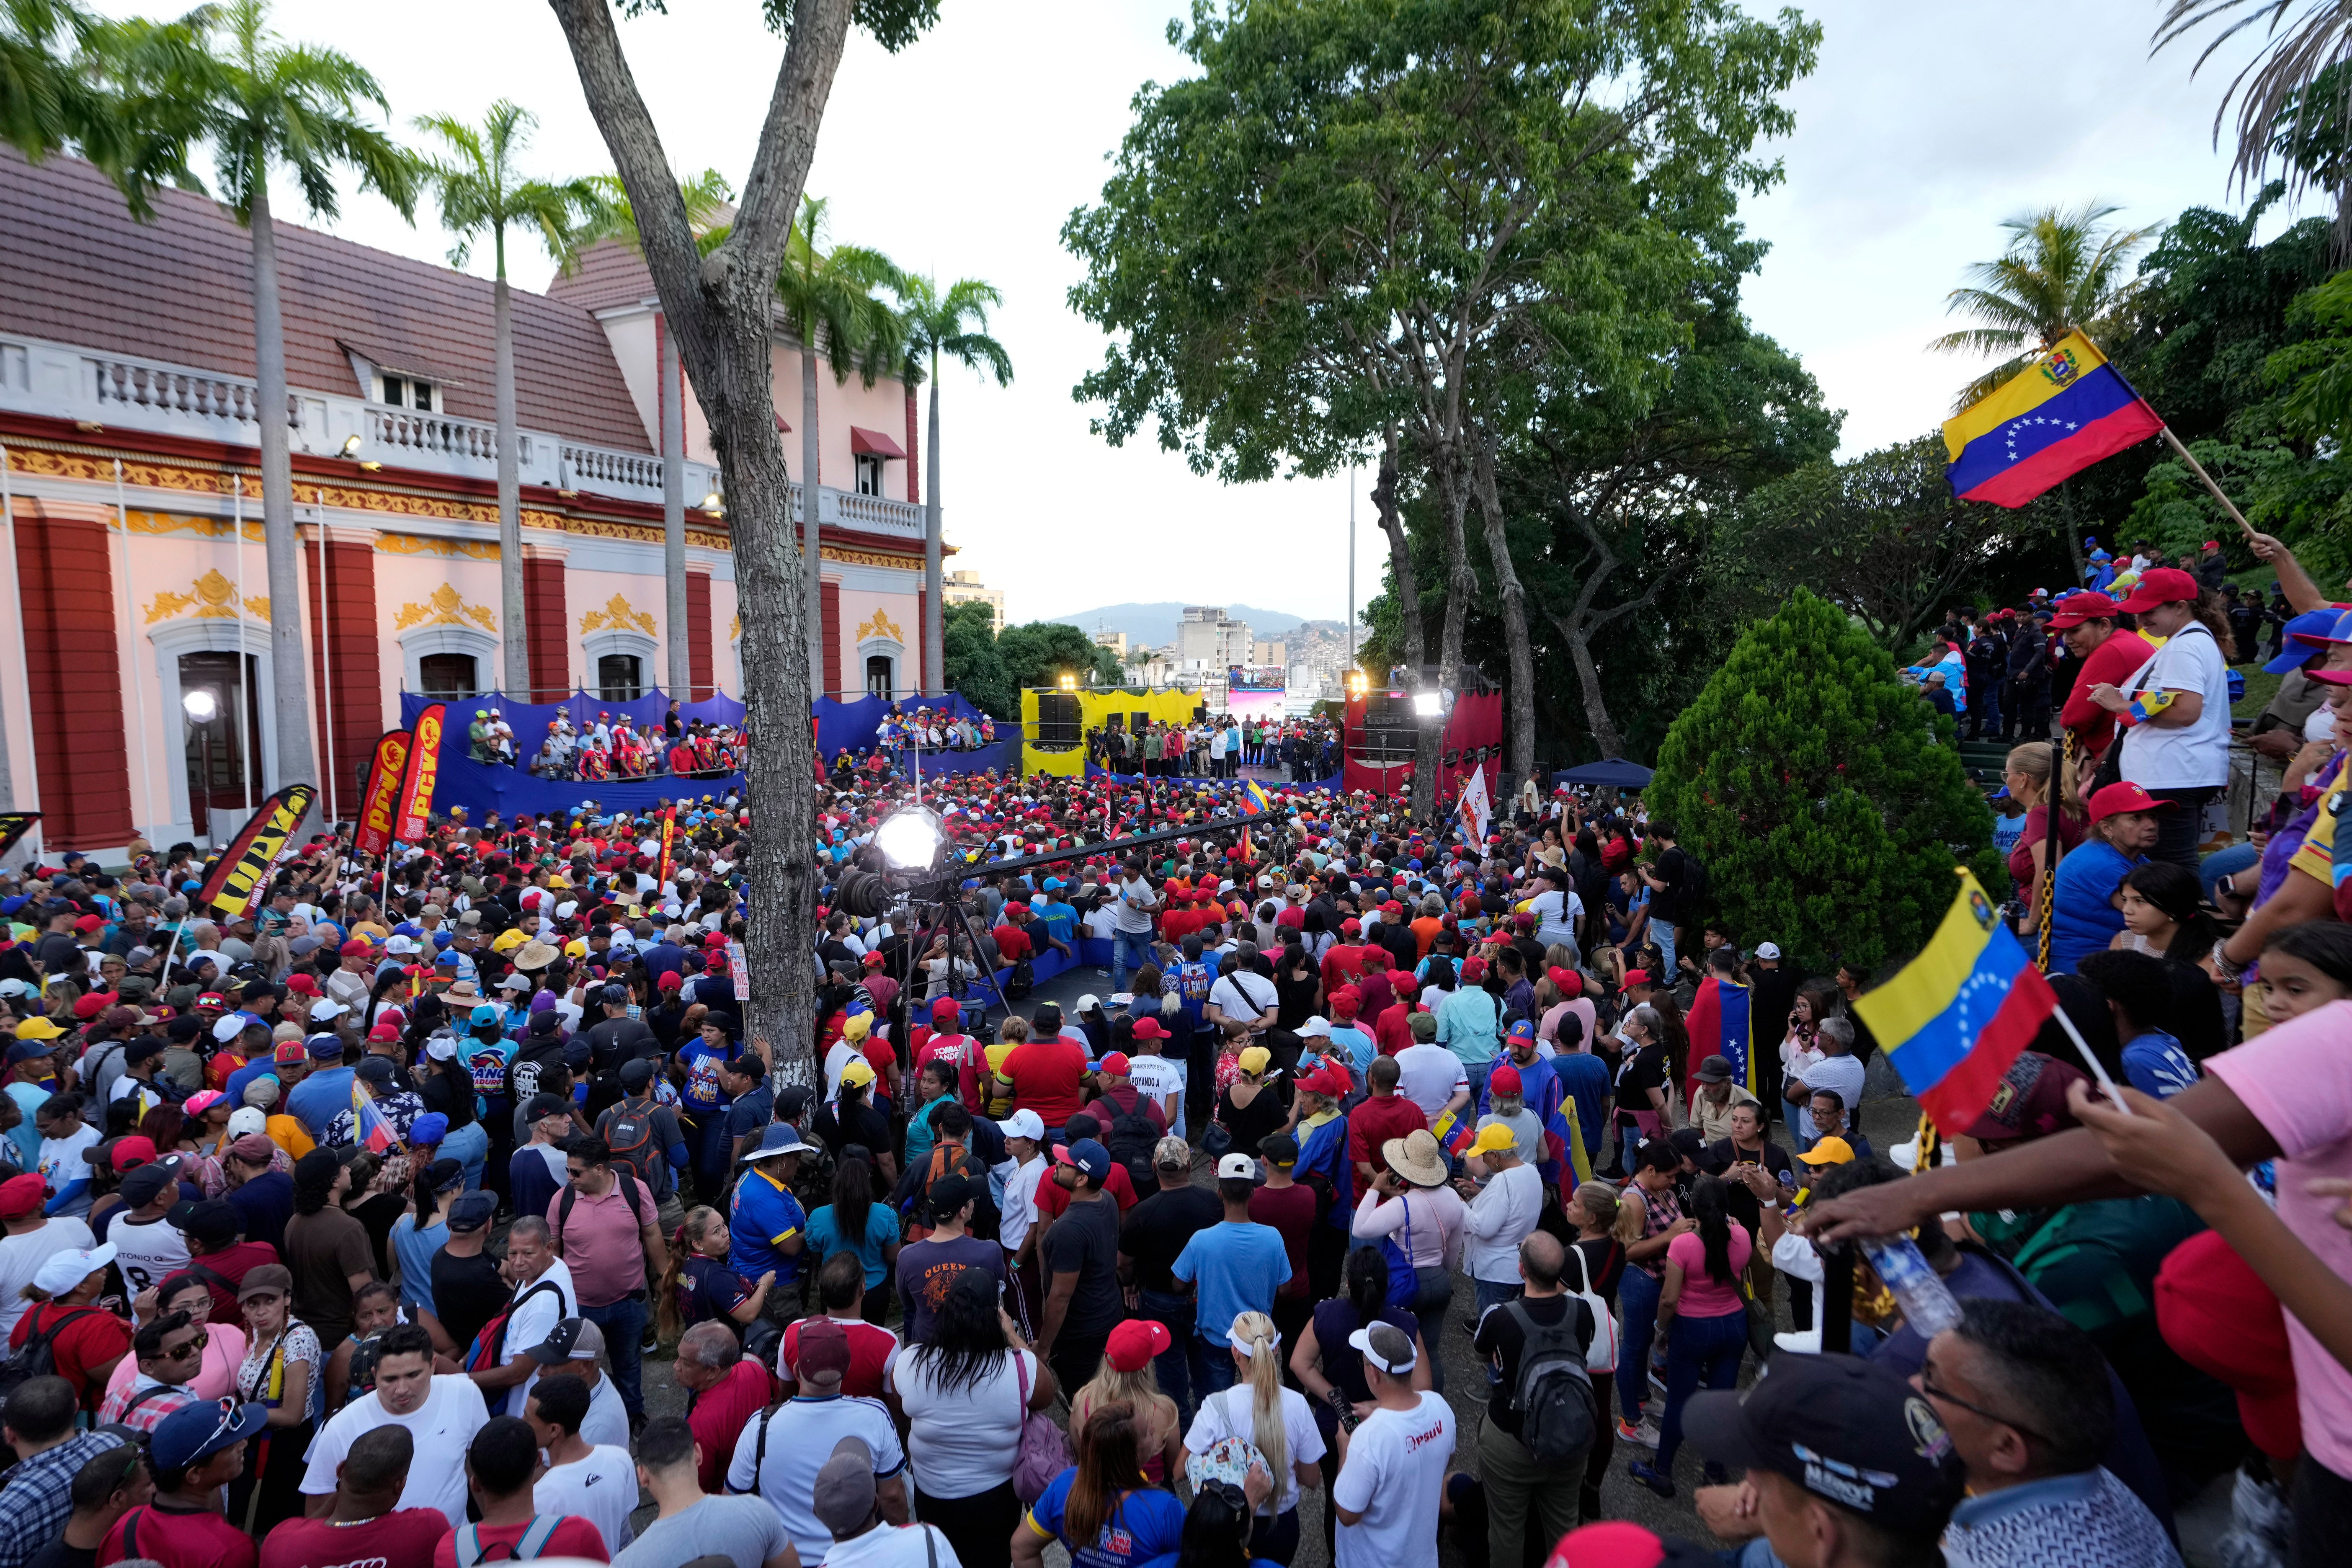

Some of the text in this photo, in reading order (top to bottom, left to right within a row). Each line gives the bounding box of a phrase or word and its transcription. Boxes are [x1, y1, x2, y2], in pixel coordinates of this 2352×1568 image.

[411, 774, 420, 797] COMUNISTA
[413, 750, 436, 817] PCV
[1996, 830, 2021, 840] VAMOS
[1156, 1078, 1160, 1088] A
[126, 1266, 152, 1292] 8
[925, 1263, 967, 1279] QUEEN
[1106, 1541, 1132, 1557] VIDA
[1113, 1535, 1132, 1547] PAZ
